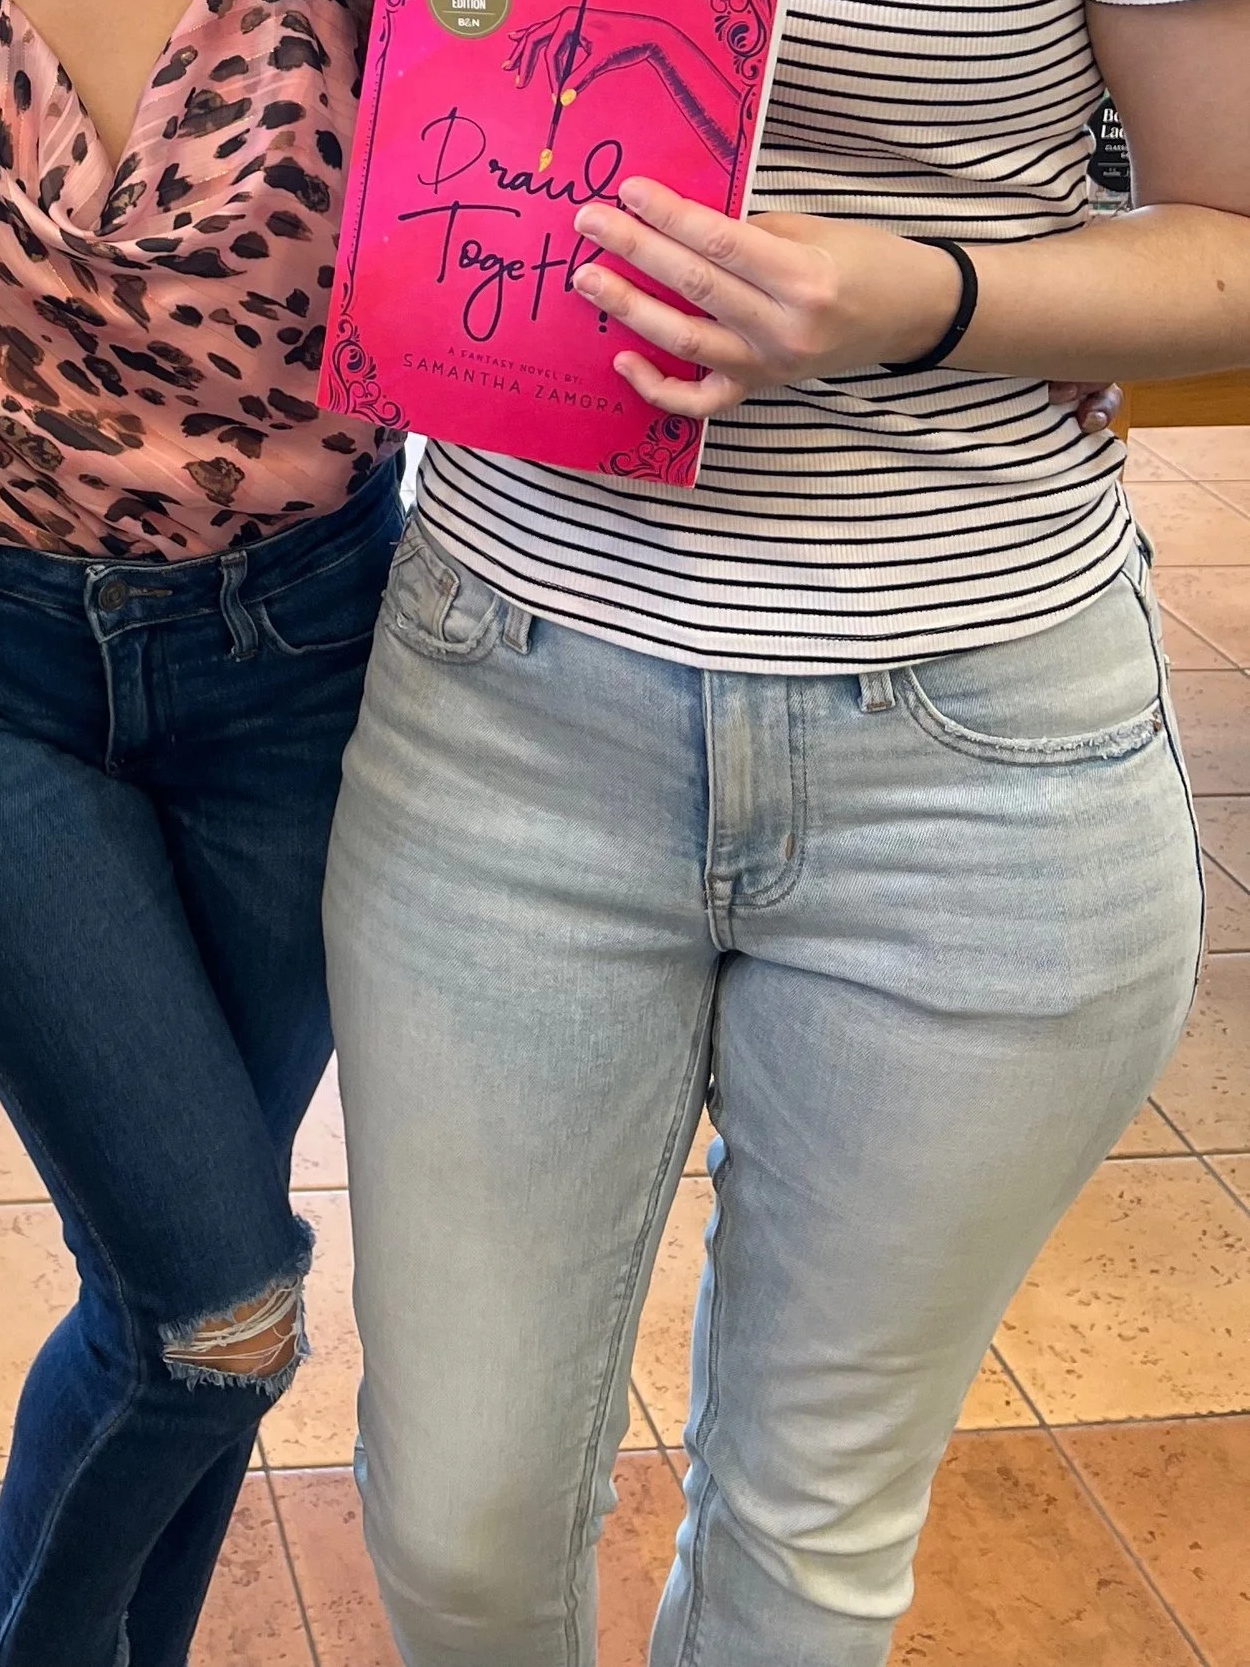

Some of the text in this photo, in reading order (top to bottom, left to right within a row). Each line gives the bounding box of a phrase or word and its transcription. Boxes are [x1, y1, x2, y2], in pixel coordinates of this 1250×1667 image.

[457, 17, 480, 27] B&N
[417, 106, 630, 211] Draw
[402, 353, 624, 415] SAMANTHA ZAMORA
[448, 346, 455, 356] A
[460, 349, 514, 370] FANTASY
[519, 364, 557, 381] NOVEL
